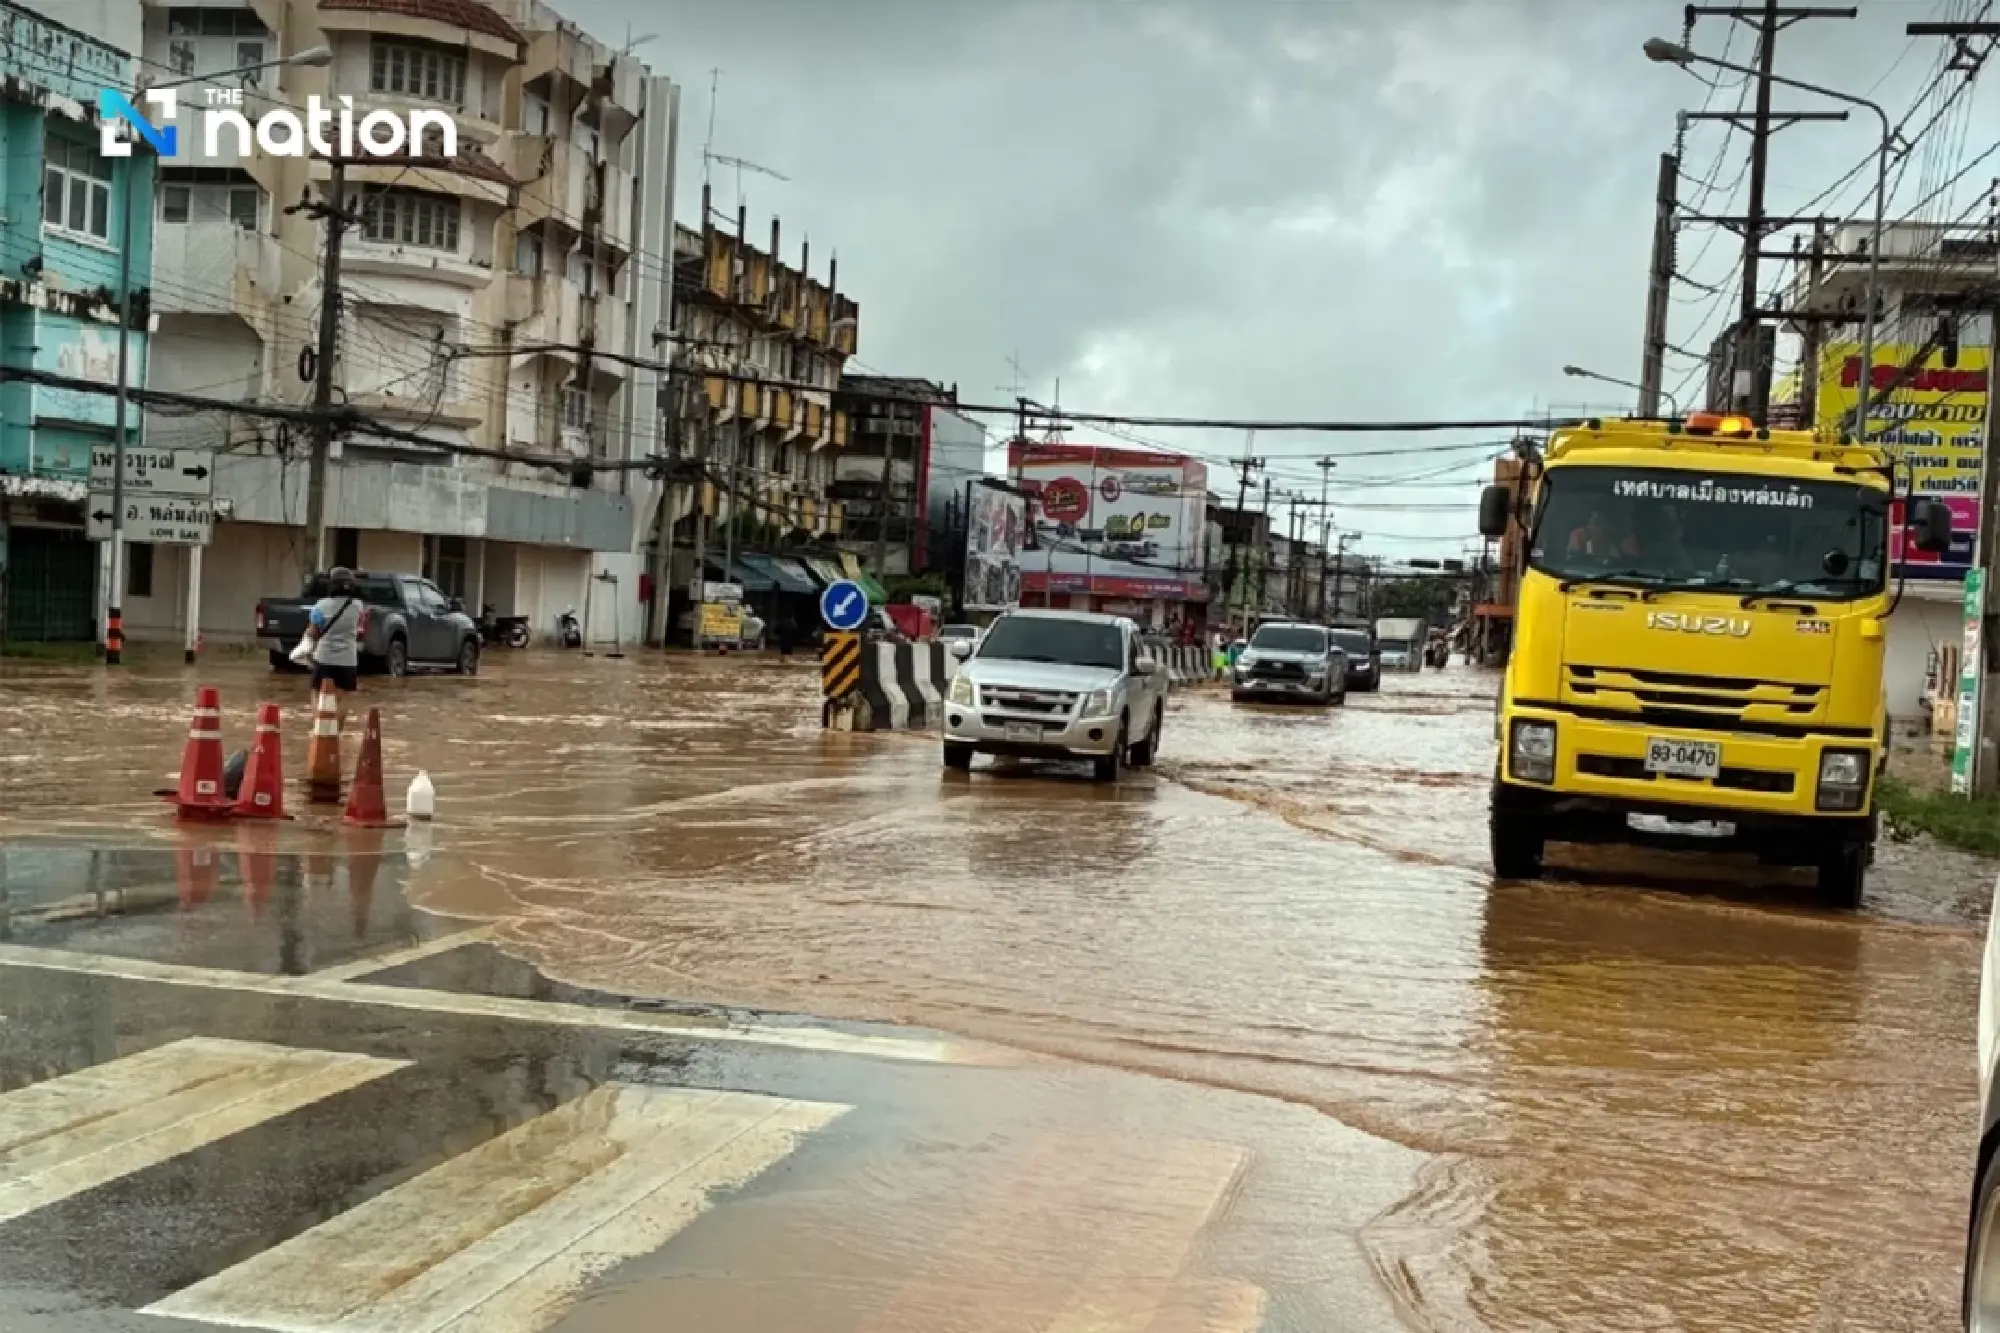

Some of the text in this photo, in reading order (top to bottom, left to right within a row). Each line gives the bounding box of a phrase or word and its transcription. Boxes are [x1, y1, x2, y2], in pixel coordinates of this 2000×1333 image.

[92, 450, 175, 477] เพรบูรณ์
[1612, 478, 1815, 509] เทศบาลเมืองหล่มสัก
[149, 501, 210, 525] หล่มสัก
[1646, 611, 1751, 638] ISUZU
